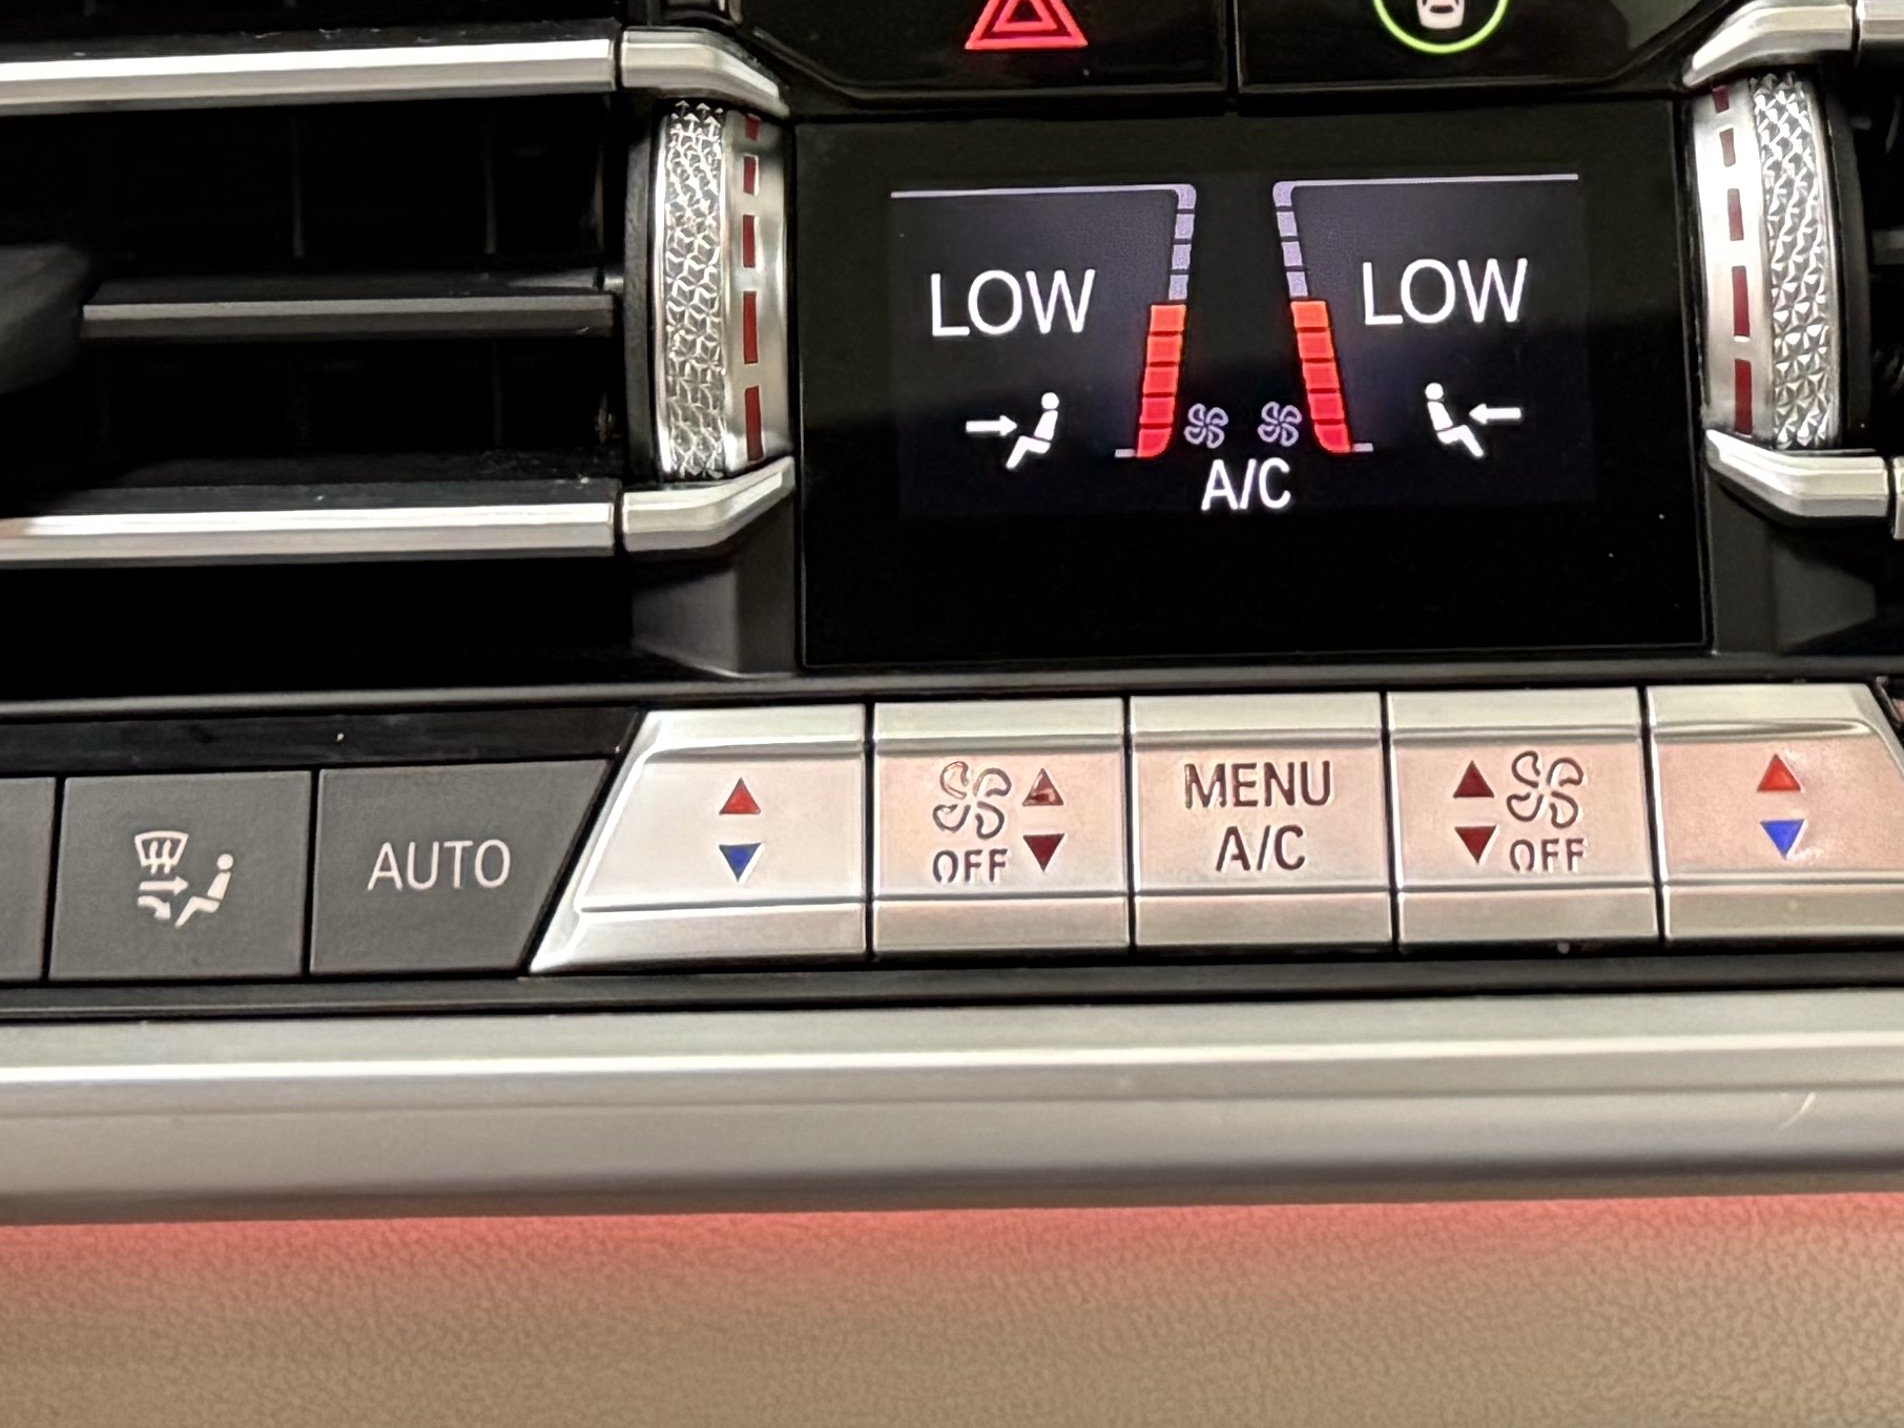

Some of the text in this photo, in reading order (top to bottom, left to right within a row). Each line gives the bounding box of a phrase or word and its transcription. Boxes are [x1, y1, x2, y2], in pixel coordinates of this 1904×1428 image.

[931, 269, 1095, 336] LOW
[1363, 258, 1527, 325] LOW
[1201, 457, 1291, 511] A/C
[1185, 761, 1330, 809] MENU
[368, 840, 510, 890] AUTO
[933, 849, 1008, 883] OFF
[1216, 825, 1305, 871] A/C
[1510, 838, 1584, 872] OFF
